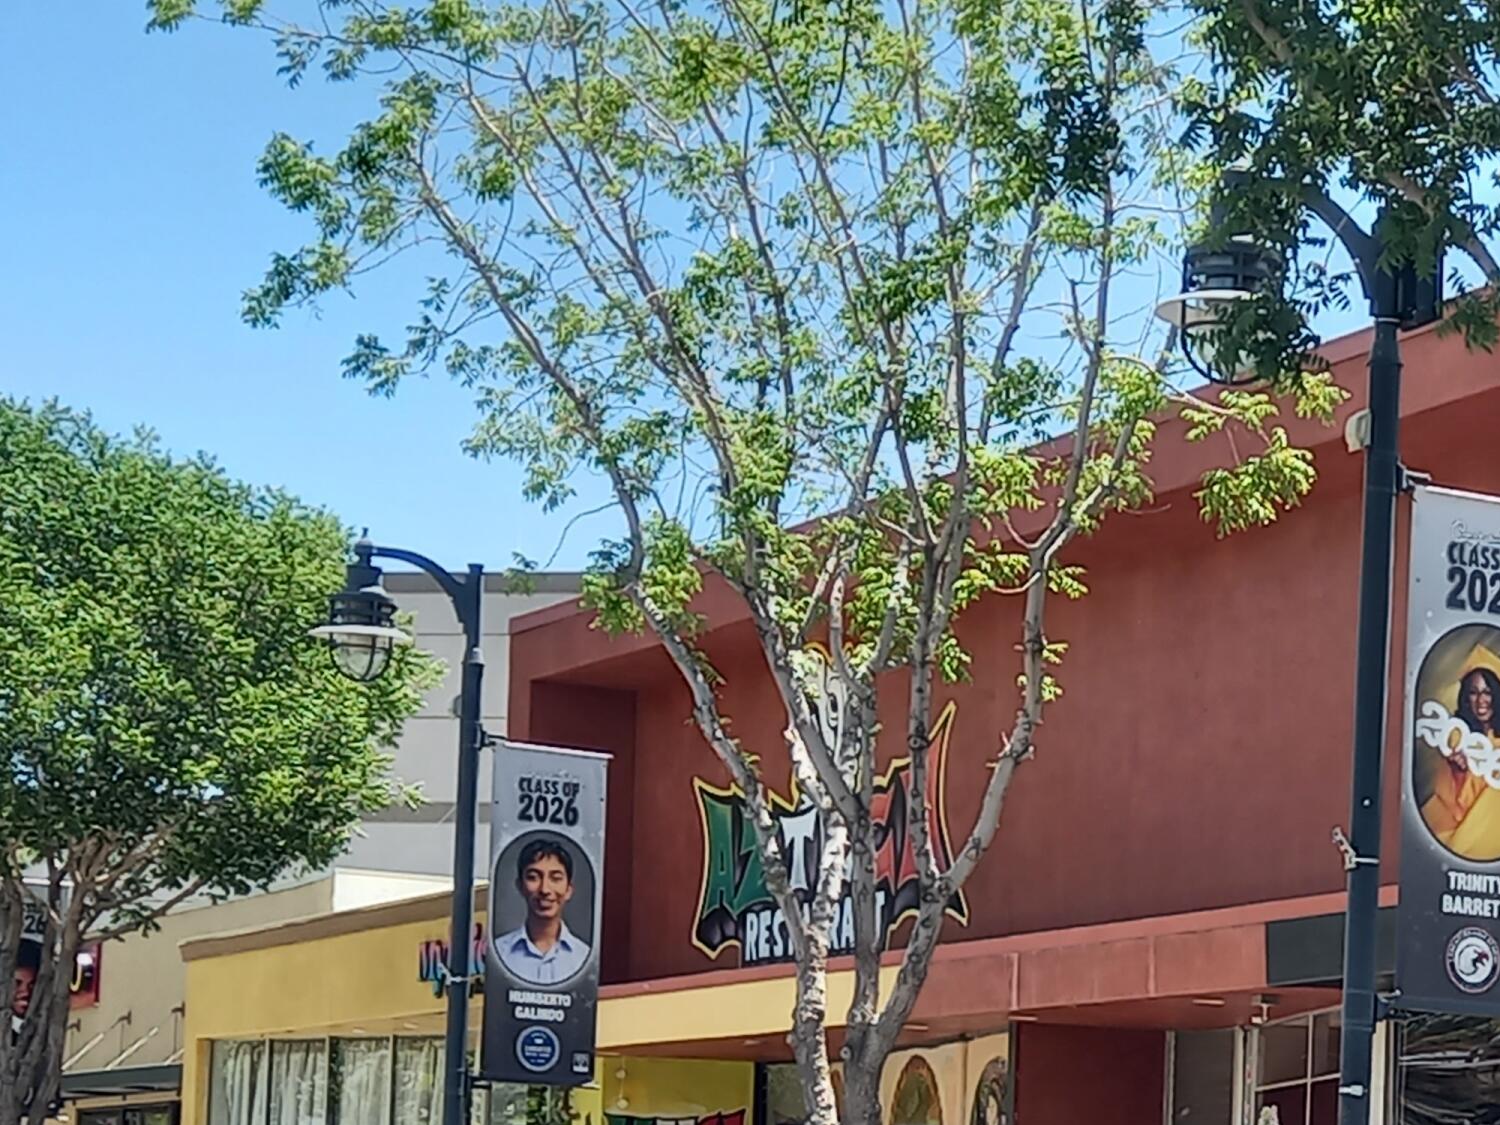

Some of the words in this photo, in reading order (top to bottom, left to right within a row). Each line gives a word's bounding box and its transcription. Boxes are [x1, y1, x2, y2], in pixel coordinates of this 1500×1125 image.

[1447, 541, 1500, 570] CLASS
[518, 777, 559, 795] CLASS
[562, 782, 580, 798] OF
[517, 794, 579, 826] 2026
